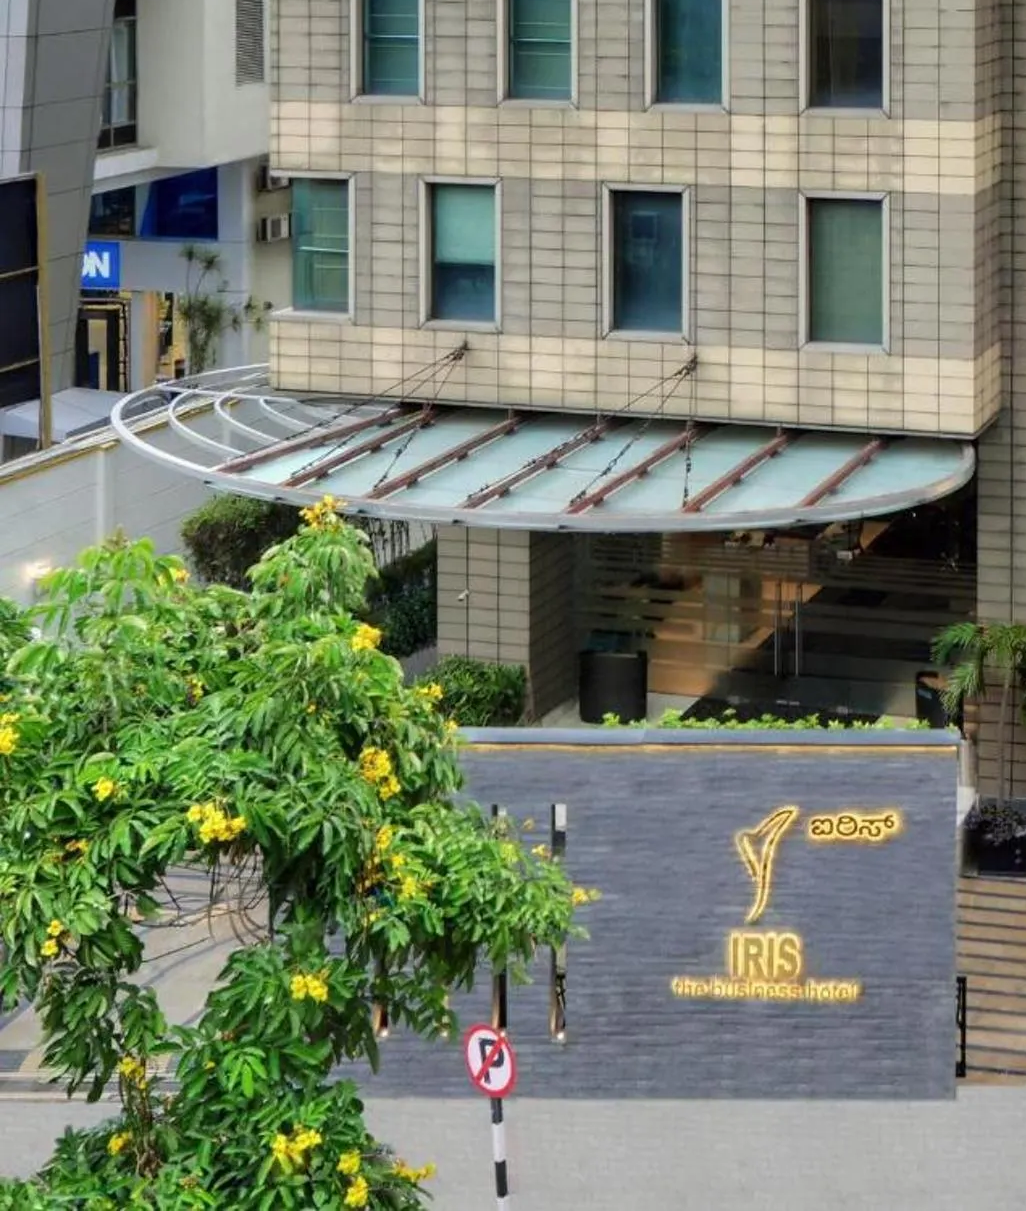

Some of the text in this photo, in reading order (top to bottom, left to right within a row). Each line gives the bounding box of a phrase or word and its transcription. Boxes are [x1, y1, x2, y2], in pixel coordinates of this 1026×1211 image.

[809, 809, 898, 842] ಐರಿಸ್
[729, 930, 802, 979] IRIS
[671, 976, 861, 1001] the business hotel
